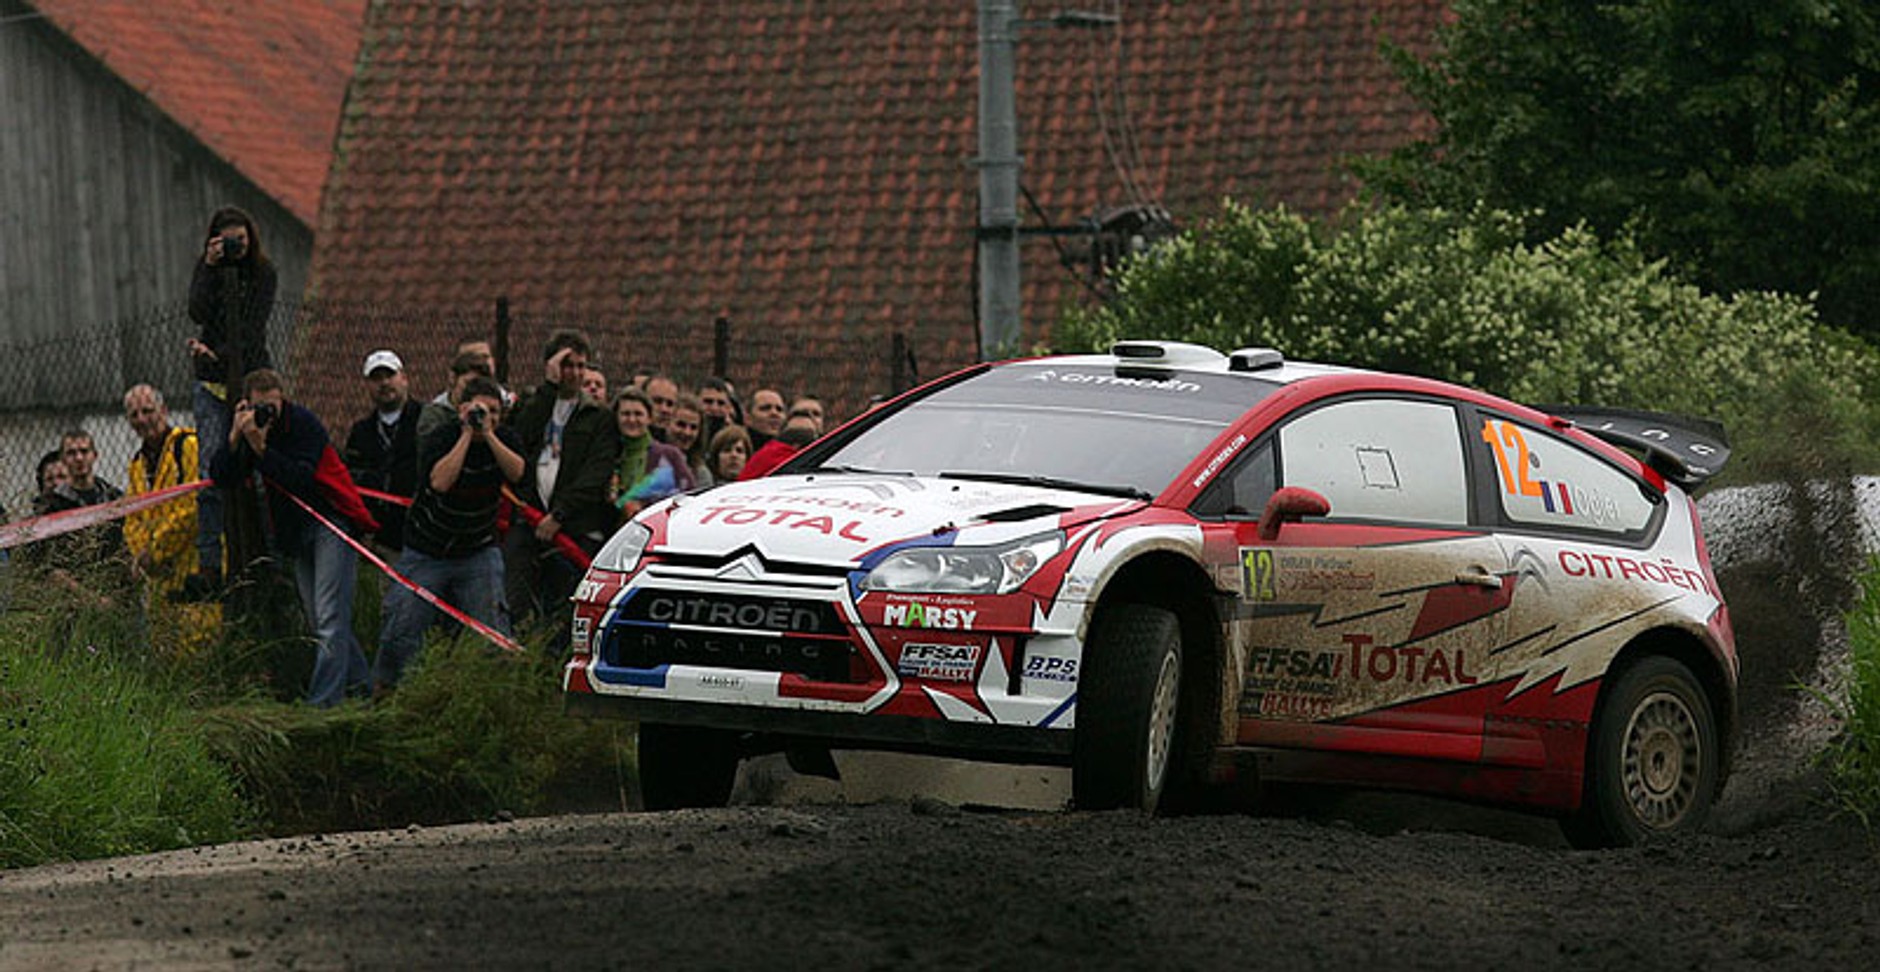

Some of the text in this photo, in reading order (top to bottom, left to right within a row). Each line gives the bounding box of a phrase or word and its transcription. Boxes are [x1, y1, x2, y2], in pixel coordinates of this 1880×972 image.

[1481, 419, 1542, 497] 12
[699, 506, 869, 543] TOTAL
[1245, 551, 1275, 600] 12
[883, 601, 977, 630] MARSY
[904, 646, 969, 659] FFSA
[1027, 656, 1077, 673] BPS
[1342, 634, 1477, 684] TOTAL
